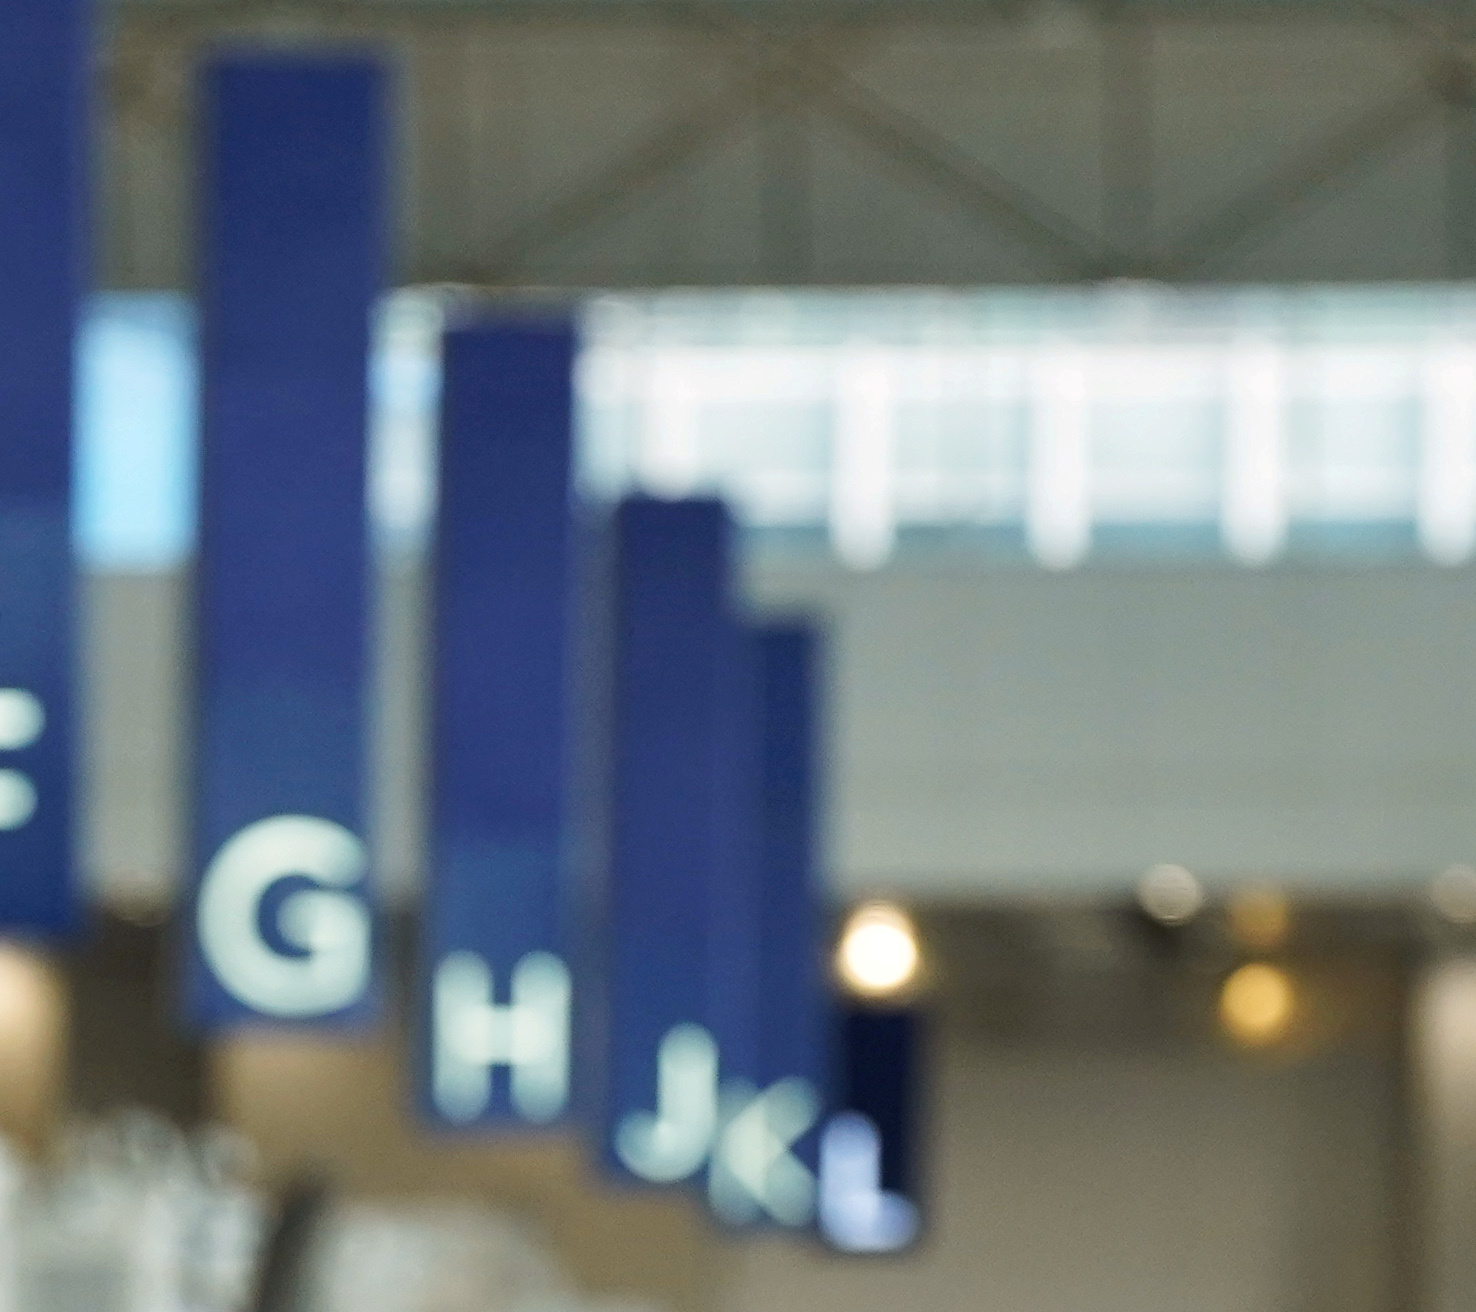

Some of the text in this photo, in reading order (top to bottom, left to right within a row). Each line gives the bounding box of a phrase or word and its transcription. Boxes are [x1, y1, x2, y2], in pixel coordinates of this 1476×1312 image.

[199, 814, 370, 1015] G
[434, 952, 571, 1120] H
[616, 1024, 720, 1183] J
[710, 1078, 820, 1226] K
[818, 1112, 918, 1254] L
